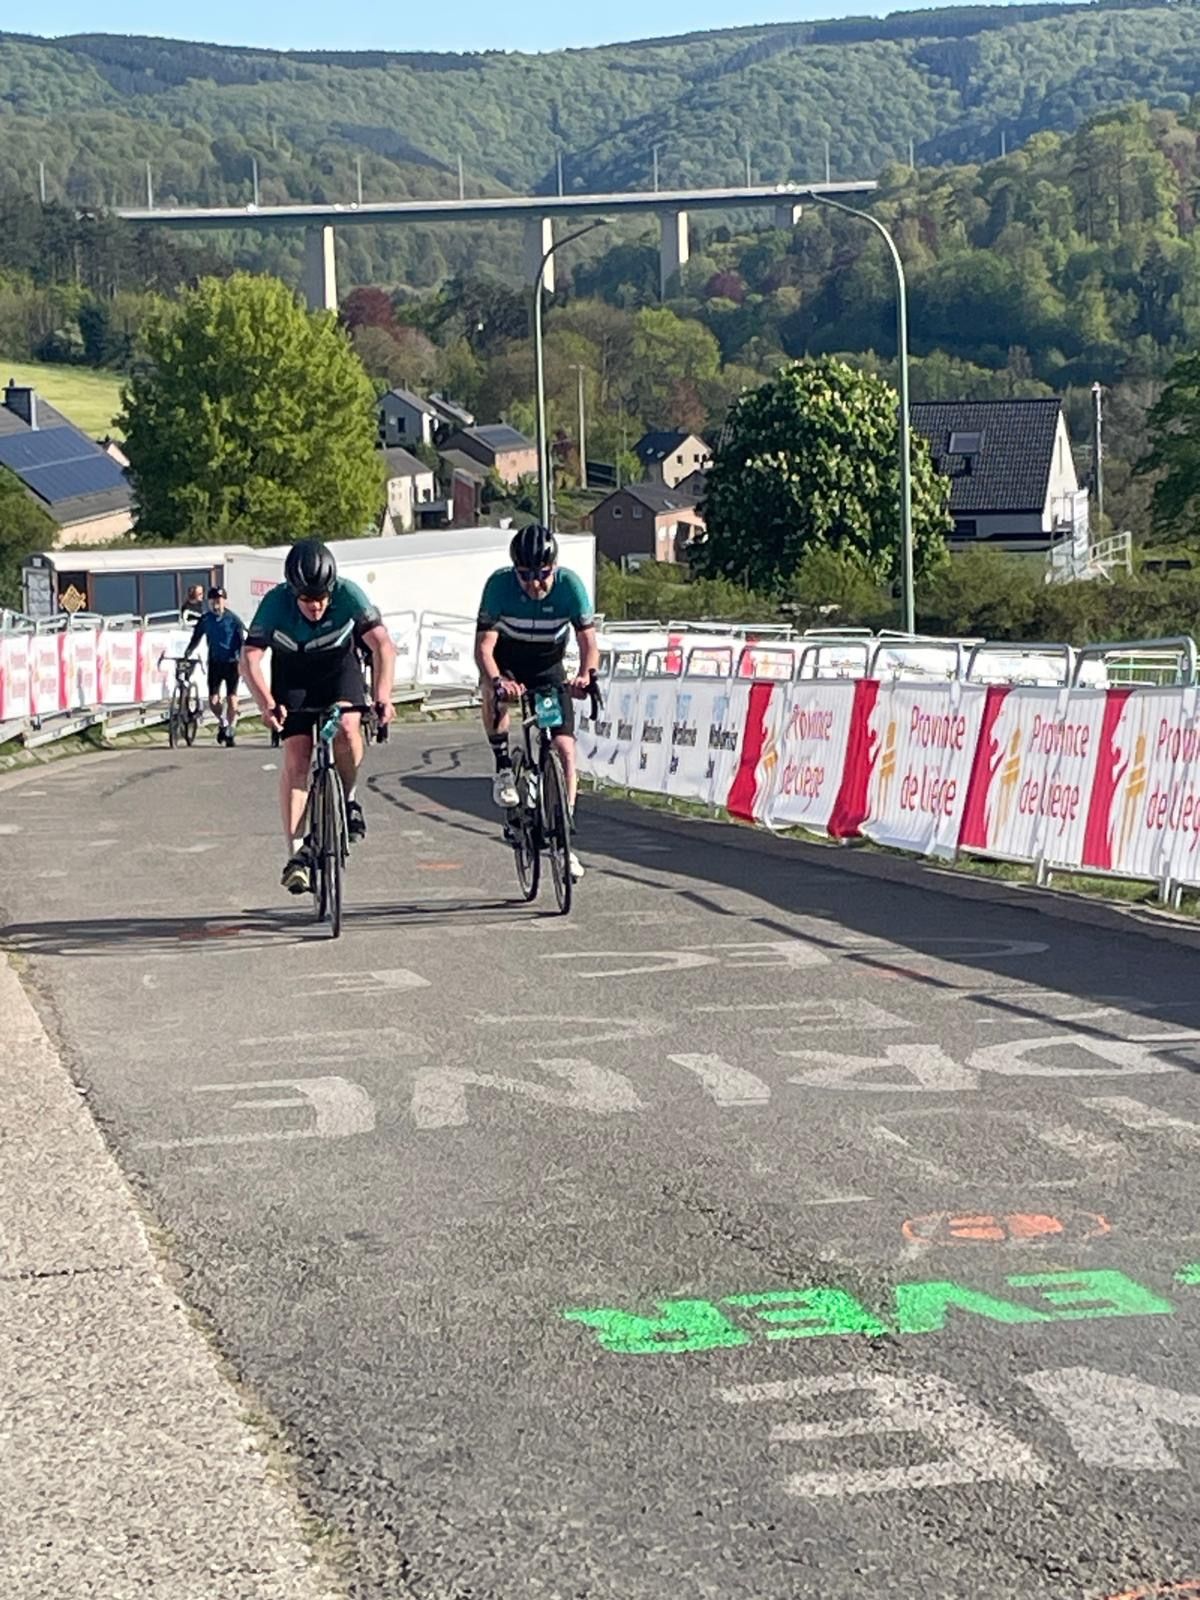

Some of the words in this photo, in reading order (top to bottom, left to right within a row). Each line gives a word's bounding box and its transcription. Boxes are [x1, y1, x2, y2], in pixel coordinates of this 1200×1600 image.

[908, 705, 966, 751] Province
[1029, 713, 1090, 758] Province
[900, 764, 919, 811] de
[1019, 768, 1039, 815] de
[1146, 780, 1168, 830] de
[134, 1031, 1200, 1149] DRINE
[564, 1261, 1200, 1354] EVER
